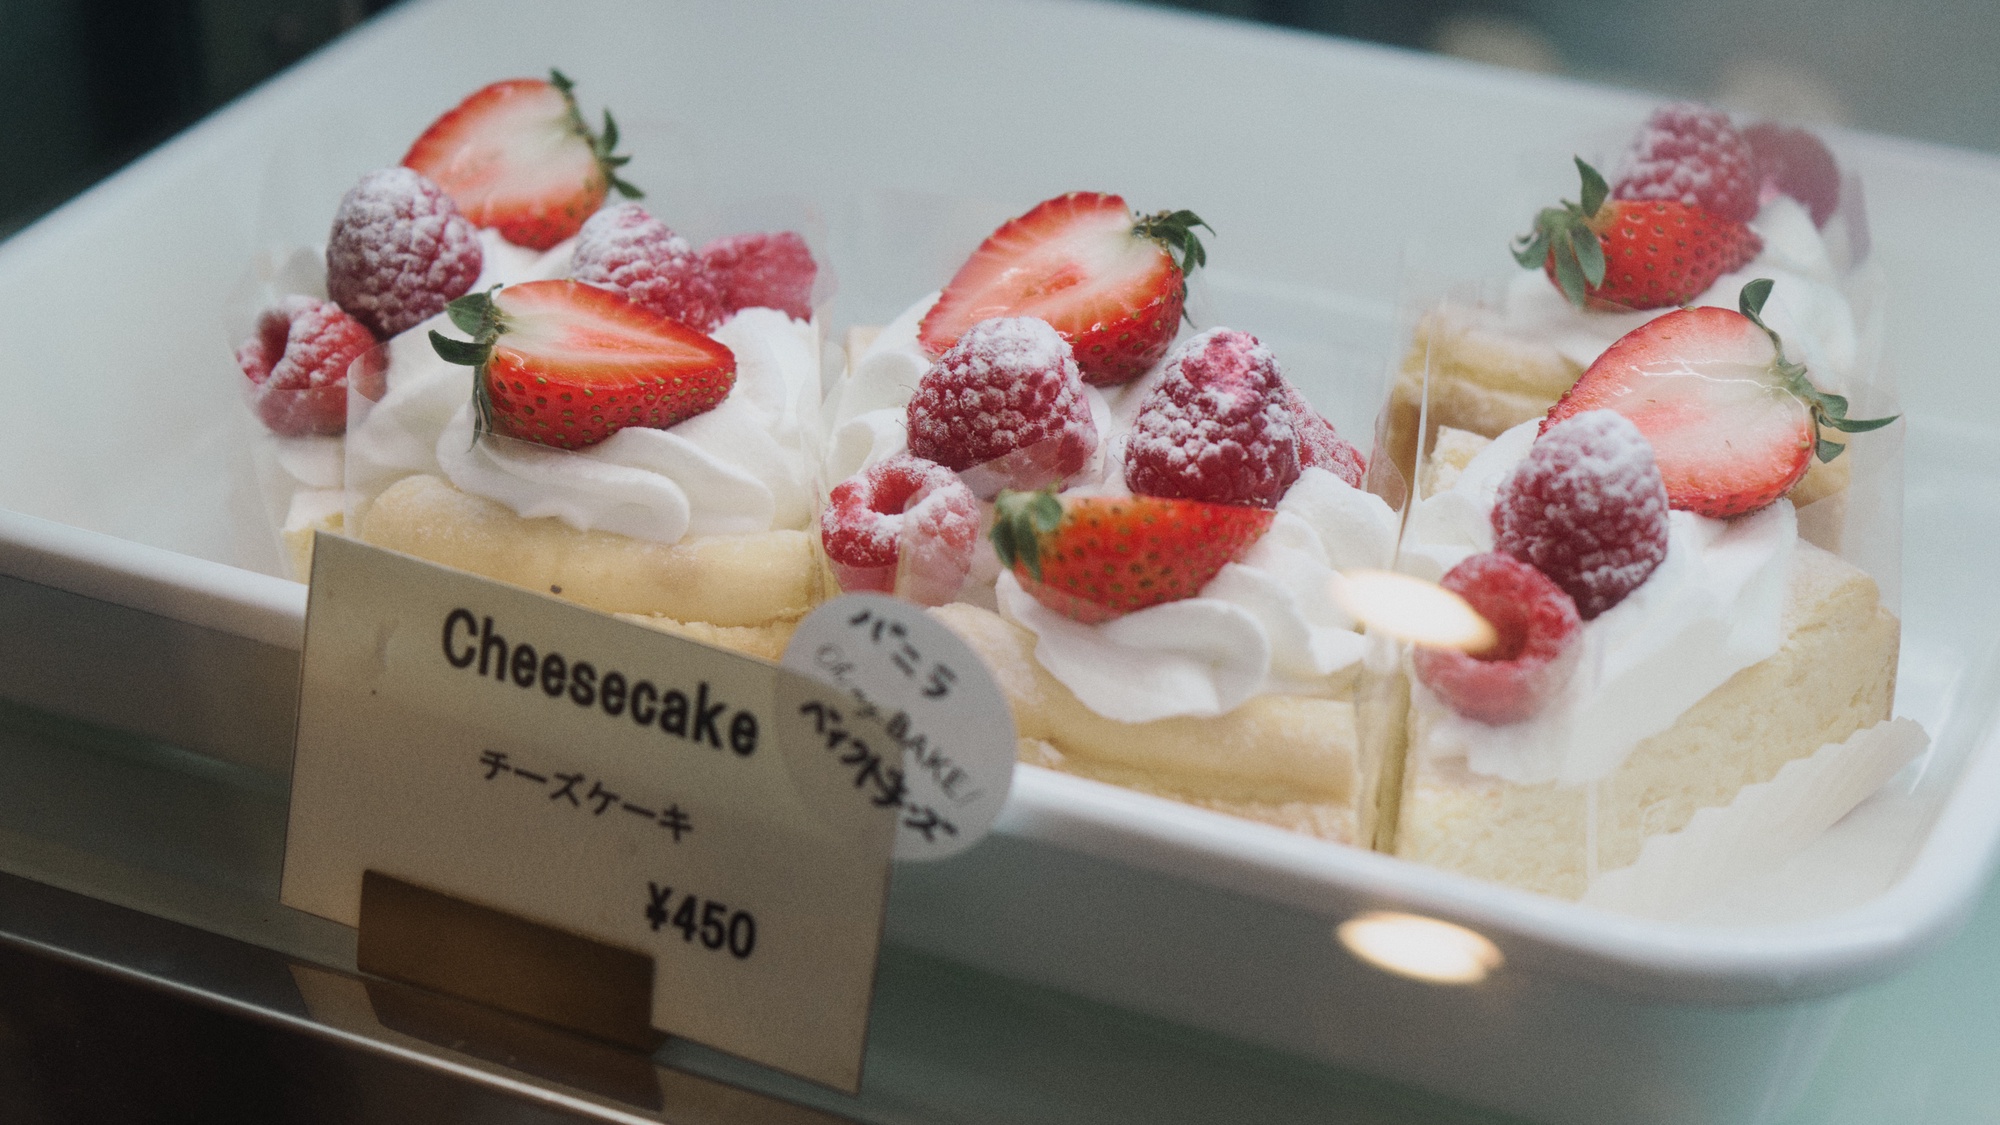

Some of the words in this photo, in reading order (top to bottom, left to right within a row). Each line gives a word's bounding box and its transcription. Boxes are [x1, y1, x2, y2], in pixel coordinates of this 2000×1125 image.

[441, 607, 759, 757] Cheesecake
[849, 609, 958, 699] バニラ
[479, 748, 694, 843] チーズケーキ
[645, 880, 757, 960] ¥450
